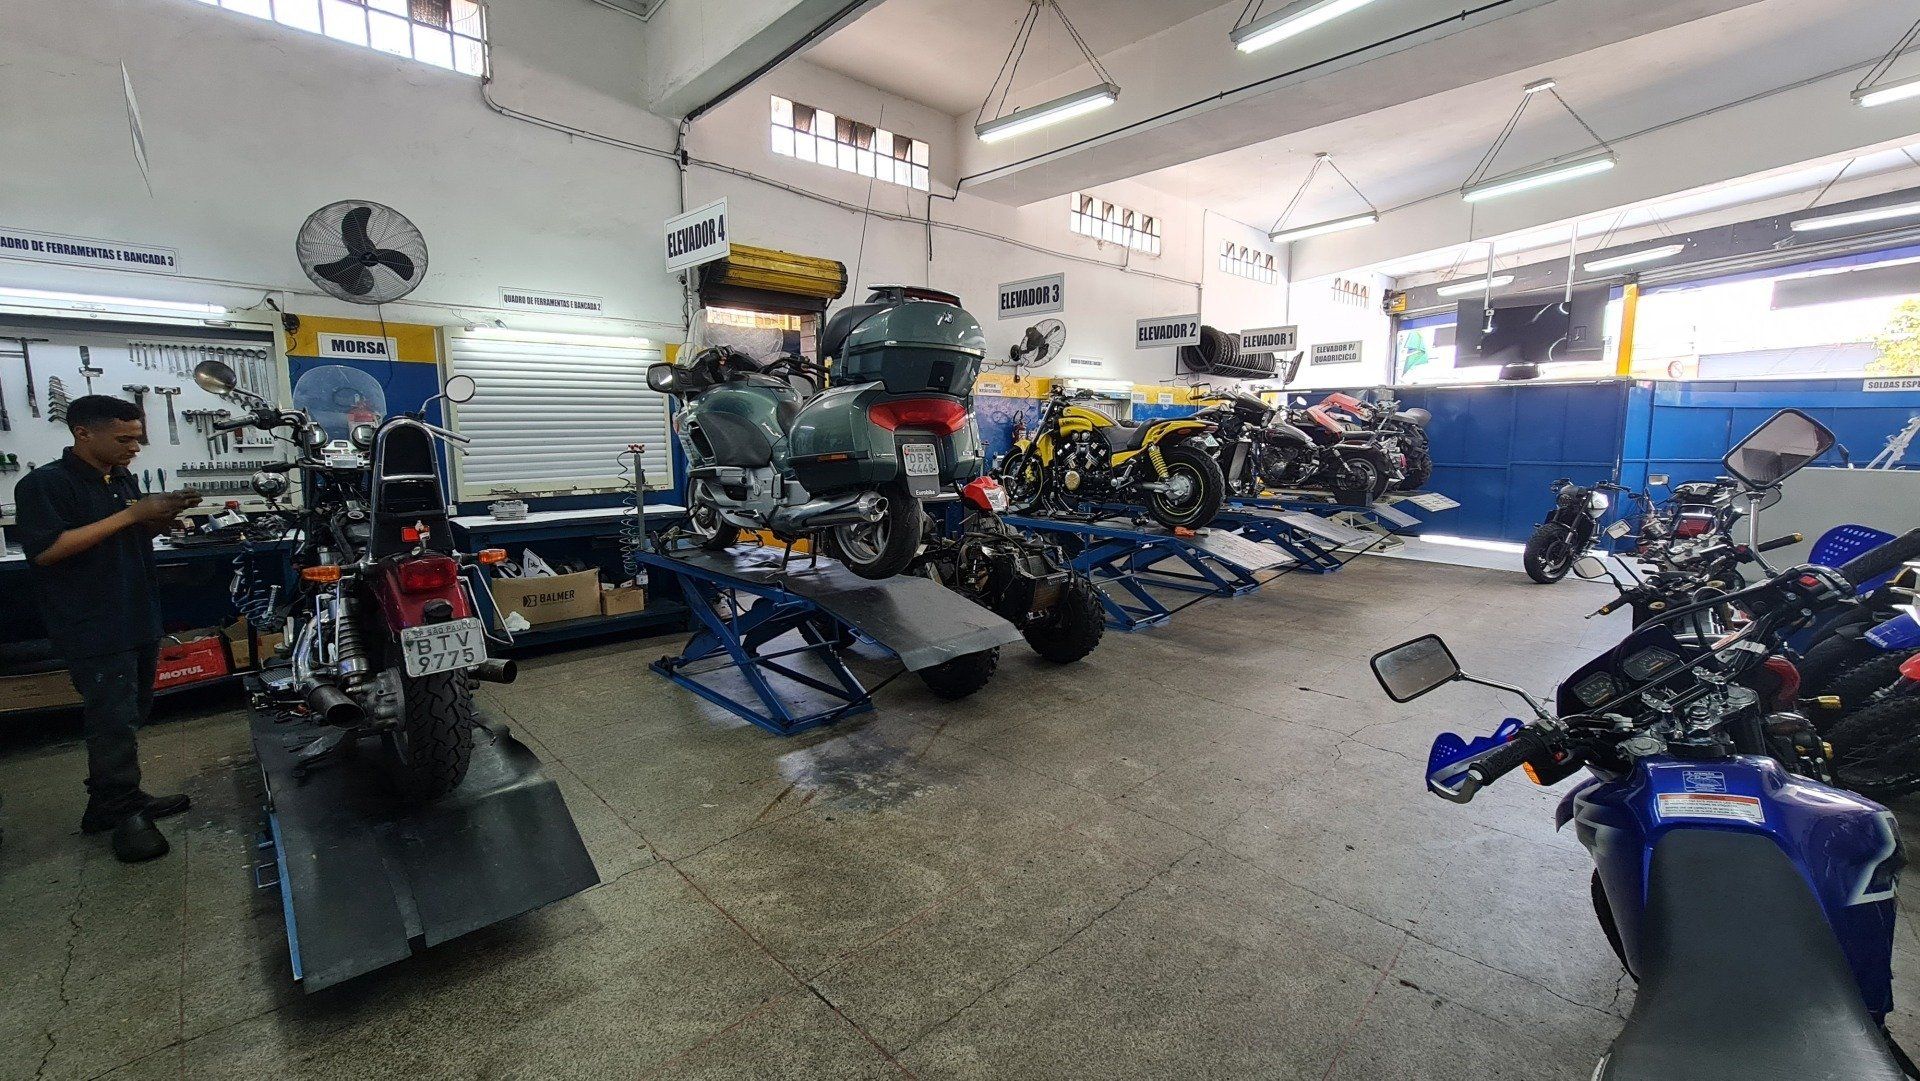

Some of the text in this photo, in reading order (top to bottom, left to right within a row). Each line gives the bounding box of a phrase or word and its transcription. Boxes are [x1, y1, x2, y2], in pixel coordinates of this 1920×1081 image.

[667, 214, 725, 258] ELEVADOR 4
[32, 240, 44, 252] DE
[46, 242, 115, 260] FERRAMENTAS
[117, 250, 122, 261] E
[124, 251, 167, 266] BANCADA
[168, 256, 174, 266] 3
[503, 294, 526, 303] QUADRO
[526, 296, 534, 305] DE
[534, 298, 570, 308] FERRAMENTAS
[574, 301, 597, 311] BANCADA
[597, 303, 601, 311] 2
[1001, 284, 1060, 310] ELEVADOR 3
[1138, 322, 1196, 342] ELEVADOR 2
[1243, 332, 1293, 348] ELEVADOR 1
[331, 339, 386, 354] MORSA
[1316, 343, 1356, 354] ELEVADOR P/
[1314, 353, 1357, 363] QUADRICICLO
[1868, 381, 1900, 389] SOLDAS
[909, 453, 932, 464] DBR
[539, 590, 575, 603] BALMER
[417, 631, 469, 655] BTV
[419, 647, 474, 673] 9775
[159, 665, 204, 681] MOTUL
